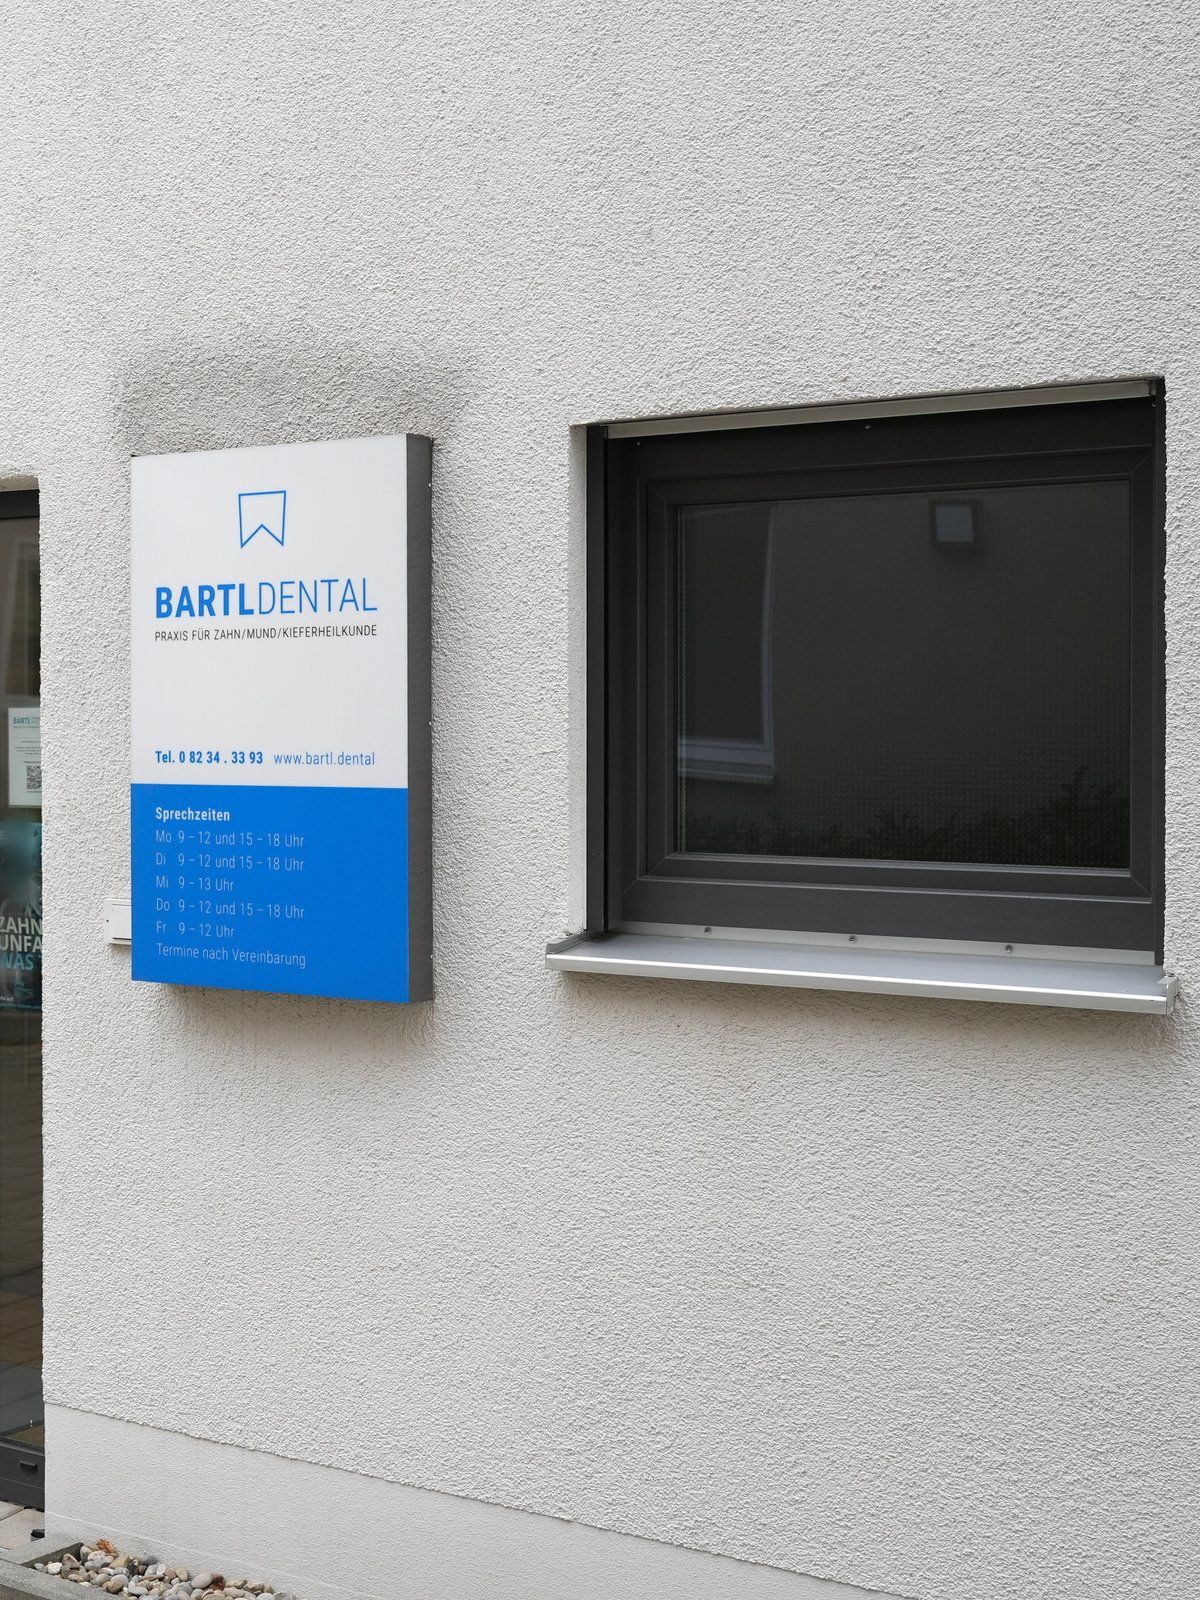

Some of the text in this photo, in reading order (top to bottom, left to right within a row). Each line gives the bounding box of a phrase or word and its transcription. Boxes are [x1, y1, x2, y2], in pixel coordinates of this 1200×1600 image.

[155, 577, 378, 620] BARTLDENTAL
[154, 624, 377, 642] PRAXIS FÜR ZAHN/MUND/KIEFERHEILKUNDE
[154, 749, 176, 765] Tel.
[273, 751, 375, 766] www.bartl.dental
[155, 806, 231, 823] Sprechzeiten
[155, 829, 172, 844] Mo
[178, 830, 185, 843] 9
[198, 831, 211, 845] 12
[215, 832, 236, 845] und
[240, 832, 253, 846] 15
[267, 833, 280, 847] 18
[284, 833, 305, 848] Uhr
[155, 852, 166, 866] Di
[178, 853, 185, 866] 9
[198, 854, 211, 868] 12
[215, 855, 236, 868] und
[240, 855, 253, 869] 15
[267, 856, 280, 870] 18
[284, 856, 305, 871] Uhr
[155, 875, 169, 888] Mi
[178, 876, 185, 889] 9
[198, 877, 211, 891] 13
[215, 878, 234, 891] Uhr
[156, 897, 170, 912] Do
[178, 899, 185, 912] 9
[198, 901, 211, 915] 12
[215, 902, 236, 915] und
[240, 902, 253, 916] 15
[267, 903, 280, 917] 18
[284, 903, 305, 918] Uhr
[156, 920, 166, 933] Fr
[178, 922, 185, 935] 9
[198, 924, 211, 938] 12
[215, 925, 234, 938] Uhr
[156, 942, 306, 970] Termine nach Vereinbarung
